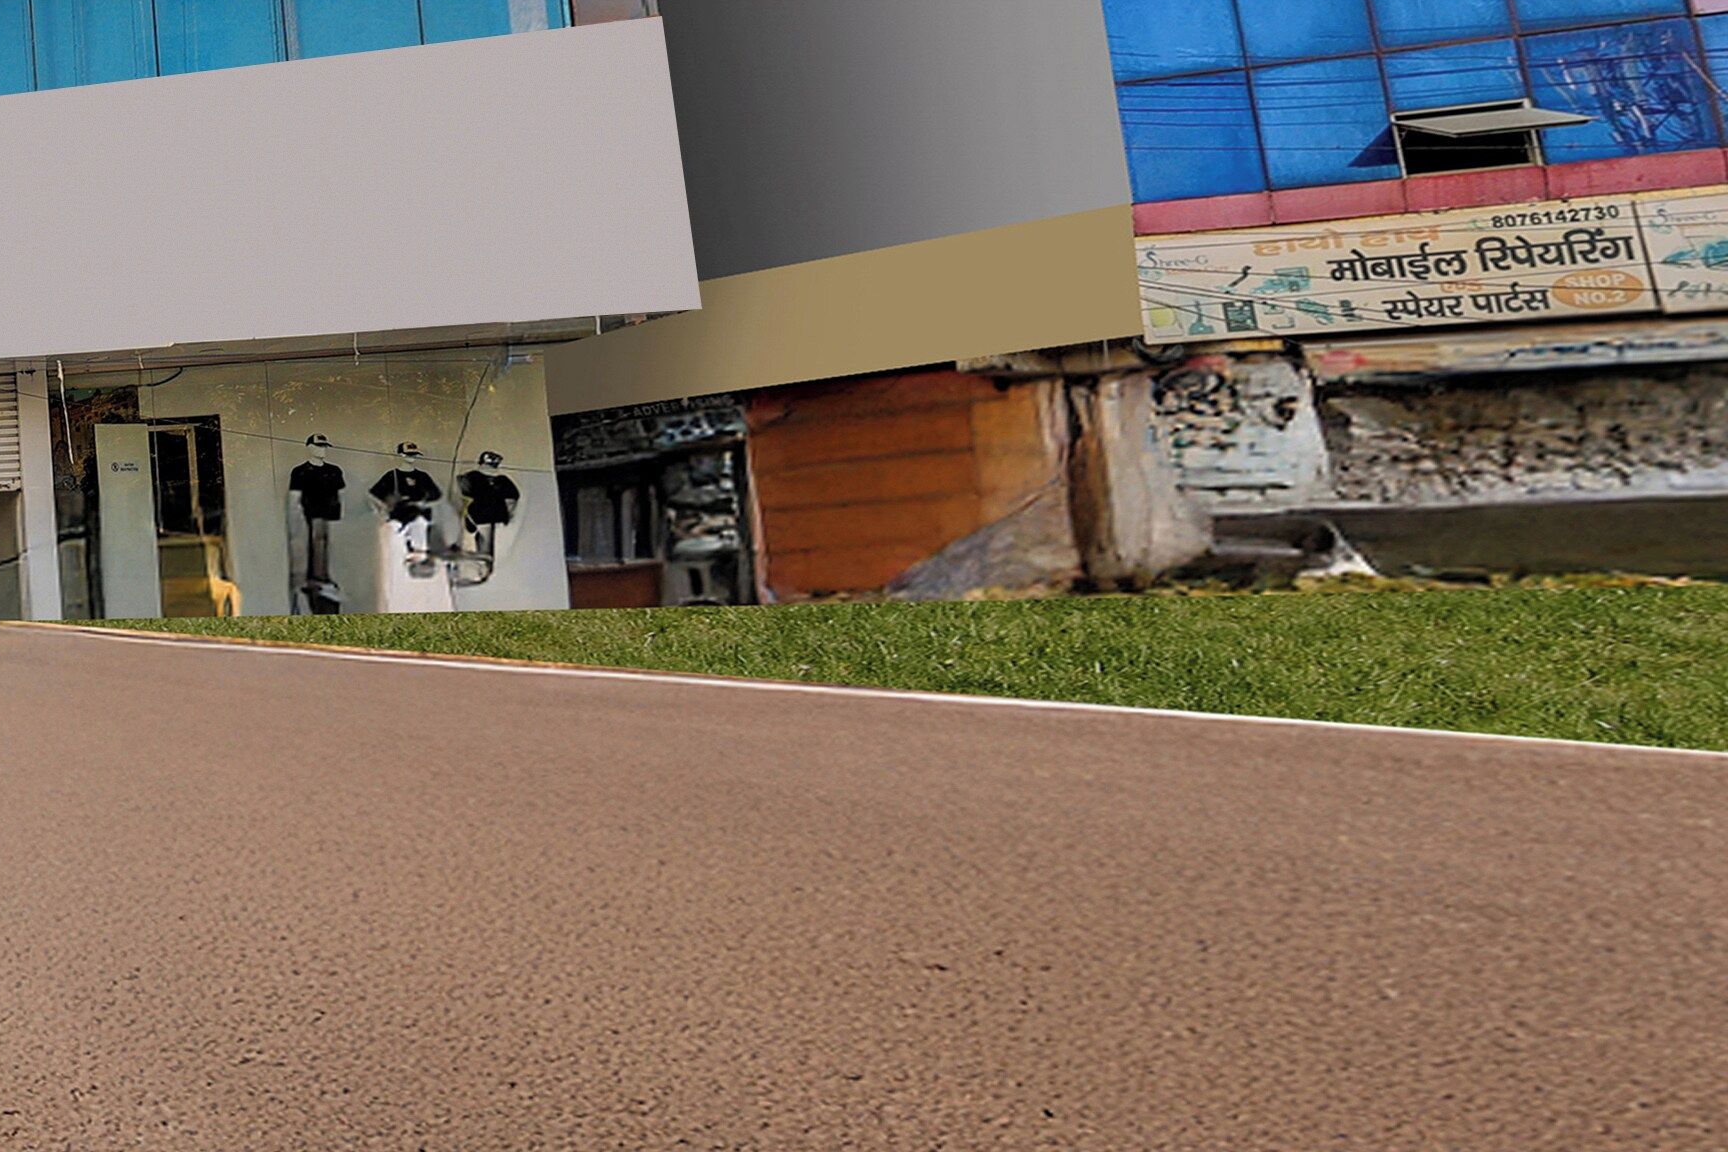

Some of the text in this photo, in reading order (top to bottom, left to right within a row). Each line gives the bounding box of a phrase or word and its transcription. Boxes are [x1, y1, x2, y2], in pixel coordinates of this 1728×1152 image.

[1491, 204, 1620, 229] 8076142730
[1326, 228, 1635, 282] मोबाईल रिपेयरिंग
[1566, 274, 1626, 288] SHOP
[1382, 282, 1551, 321] स्पेयर पार्टस
[1575, 290, 1624, 305] NO.2
